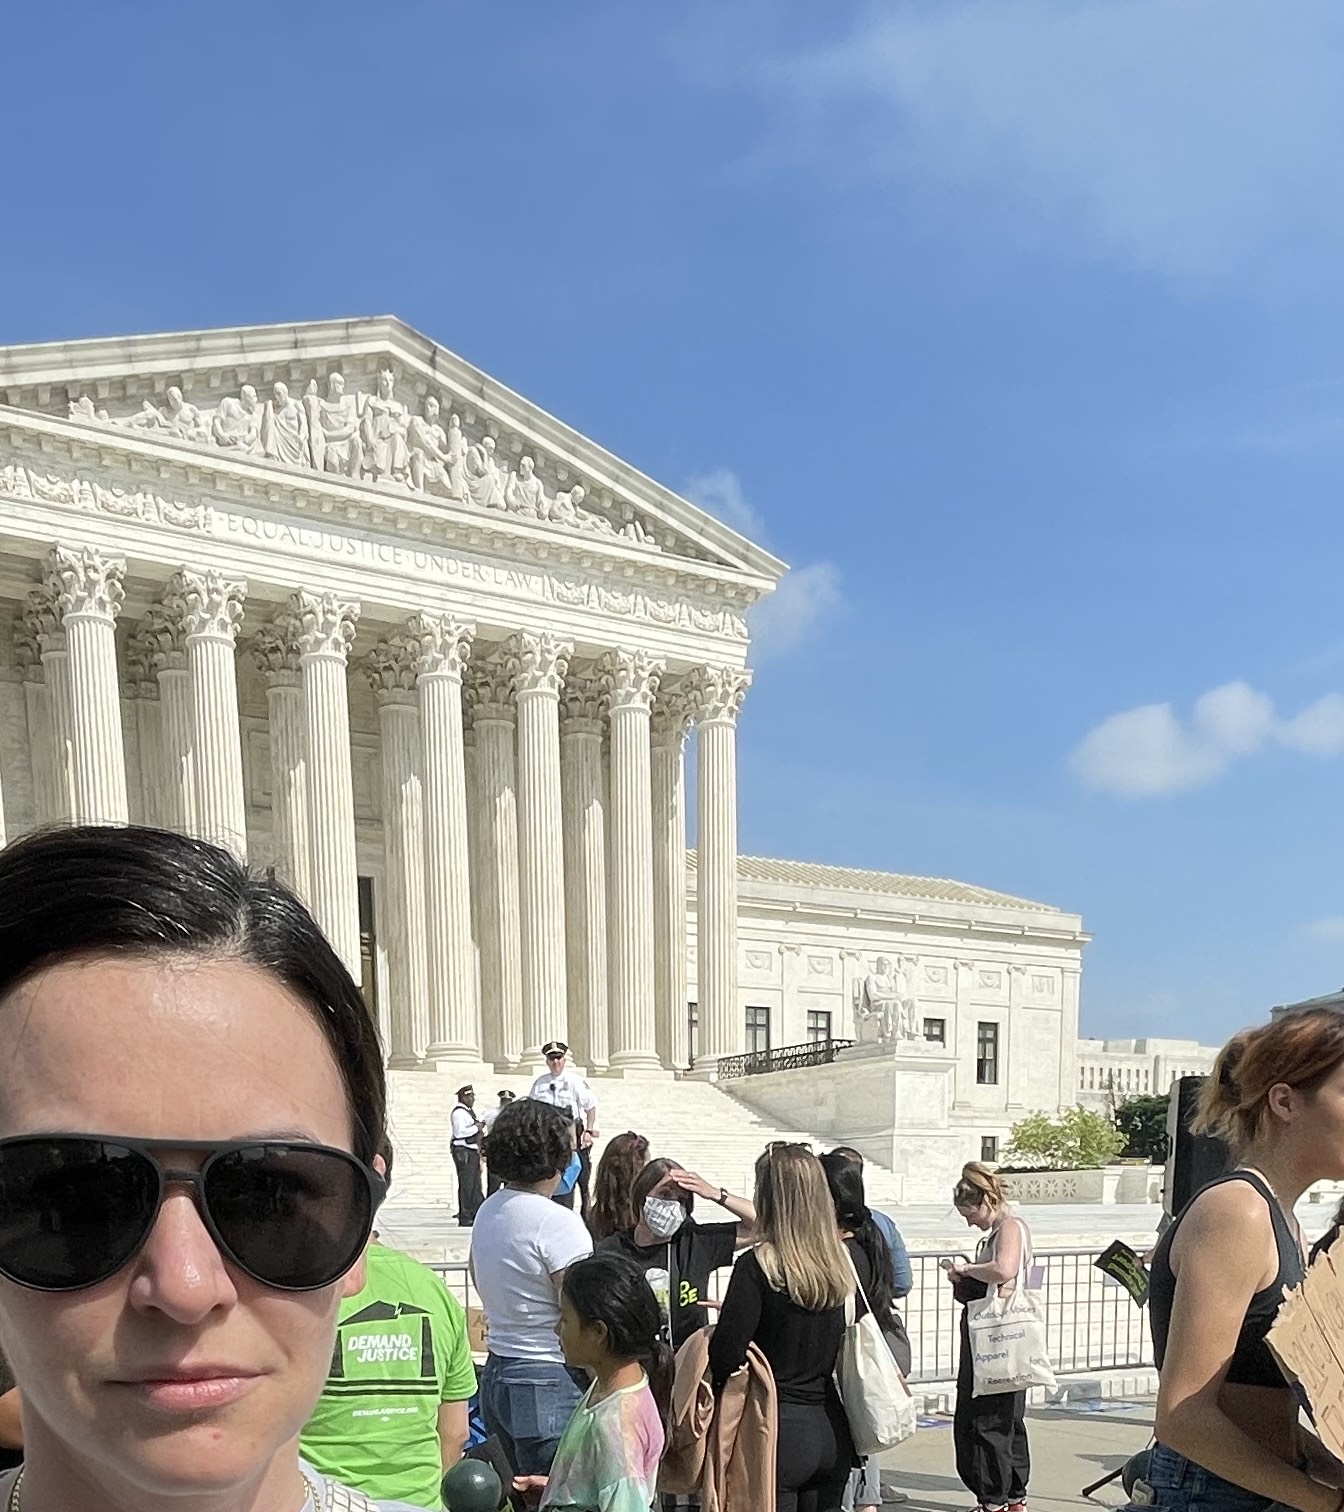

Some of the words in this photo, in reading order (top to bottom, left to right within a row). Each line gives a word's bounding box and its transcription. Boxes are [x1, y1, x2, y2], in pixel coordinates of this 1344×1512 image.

[227, 514, 308, 546] EQUAL
[313, 532, 402, 565] JUSTICE
[413, 552, 485, 582] UNDER
[493, 568, 533, 589] LAW
[348, 1334, 411, 1351] DEMAND
[988, 1329, 1025, 1343] Technical
[357, 1347, 418, 1363] JUSTICE
[976, 1350, 1009, 1364] Apparel
